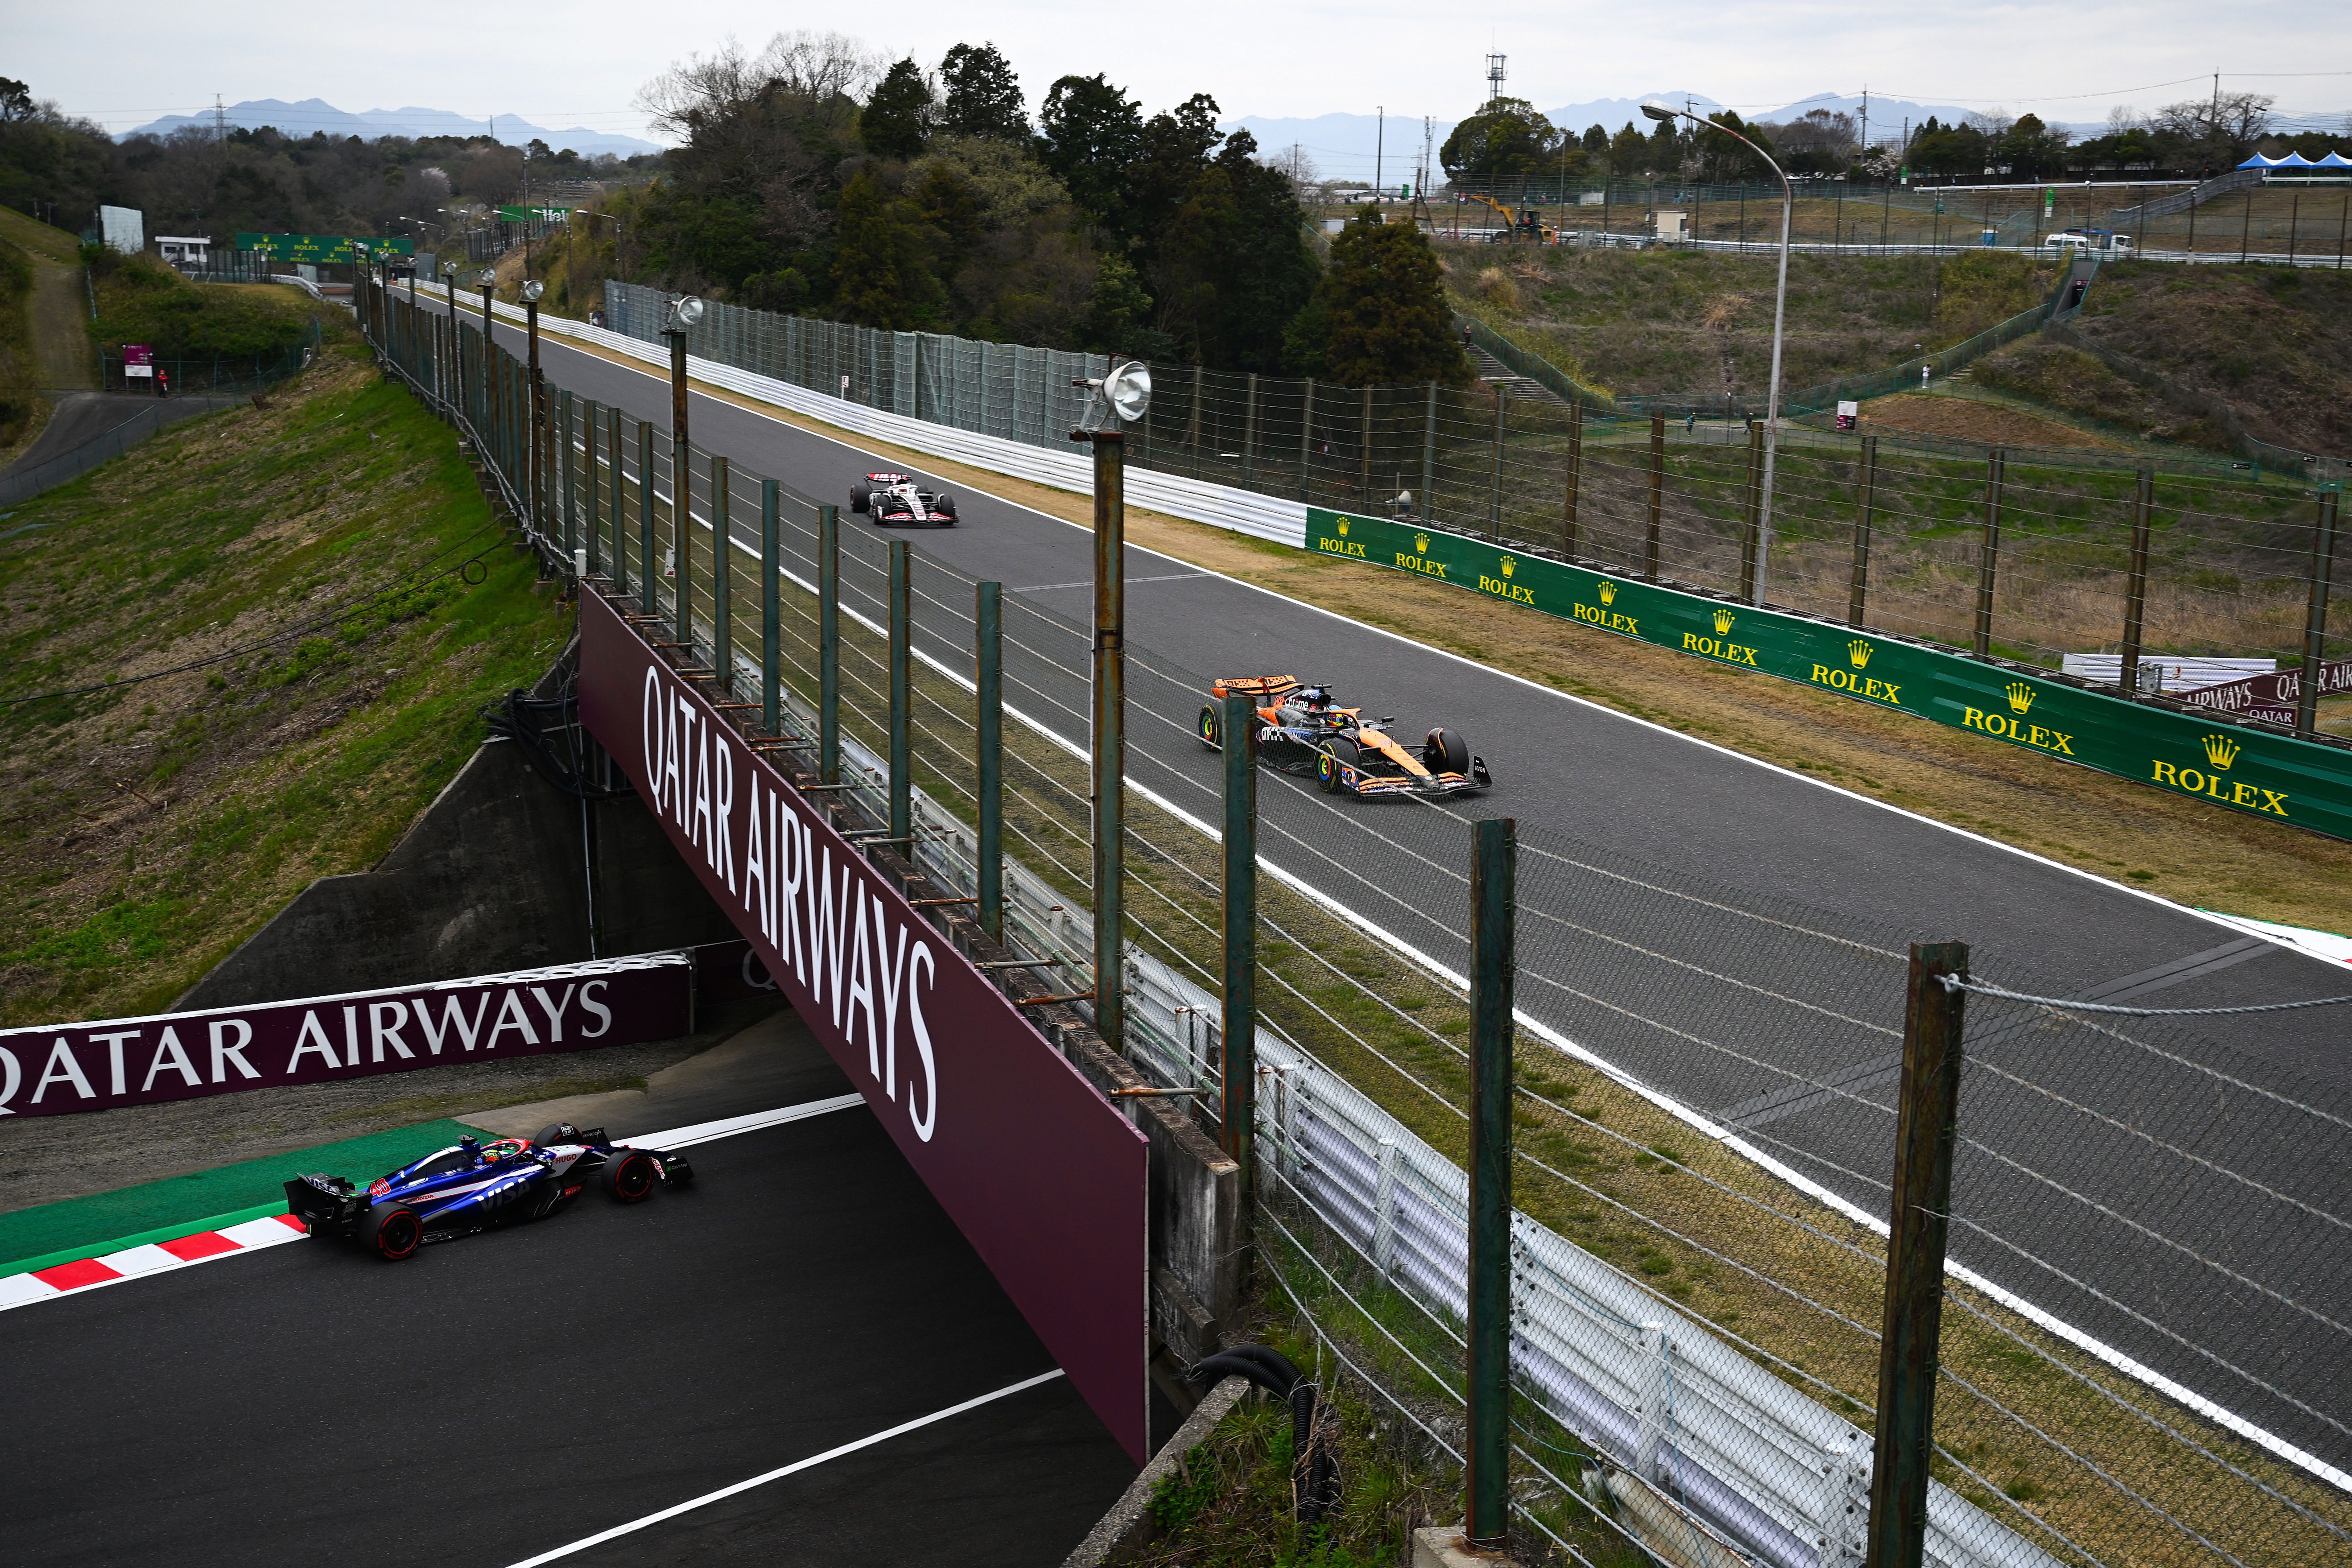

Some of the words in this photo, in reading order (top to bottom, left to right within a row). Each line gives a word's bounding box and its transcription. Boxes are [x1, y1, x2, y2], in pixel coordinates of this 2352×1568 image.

[1319, 538, 1366, 557] ROLEX
[1396, 553, 1447, 578] ROLEX
[1478, 575, 1535, 605] ROLEX
[1573, 603, 1639, 634] ROLEX
[1682, 632, 1758, 666] ROLEX
[1810, 664, 1901, 704] ROLEX
[1285, 696, 1308, 710] Chrome
[1962, 707, 2075, 755] ROLEX
[2151, 760, 2289, 816] ROLEX
[644, 666, 736, 895] QATAR
[745, 770, 937, 1142] AIRWAYS
[286, 980, 611, 1073] AIRWAYS
[556, 1153, 577, 1164] HUGO
[304, 1176, 336, 1193] VISA
[370, 1178, 391, 1197] 40
[410, 1194, 435, 1202] HONDA
[470, 1177, 531, 1213] VISA
